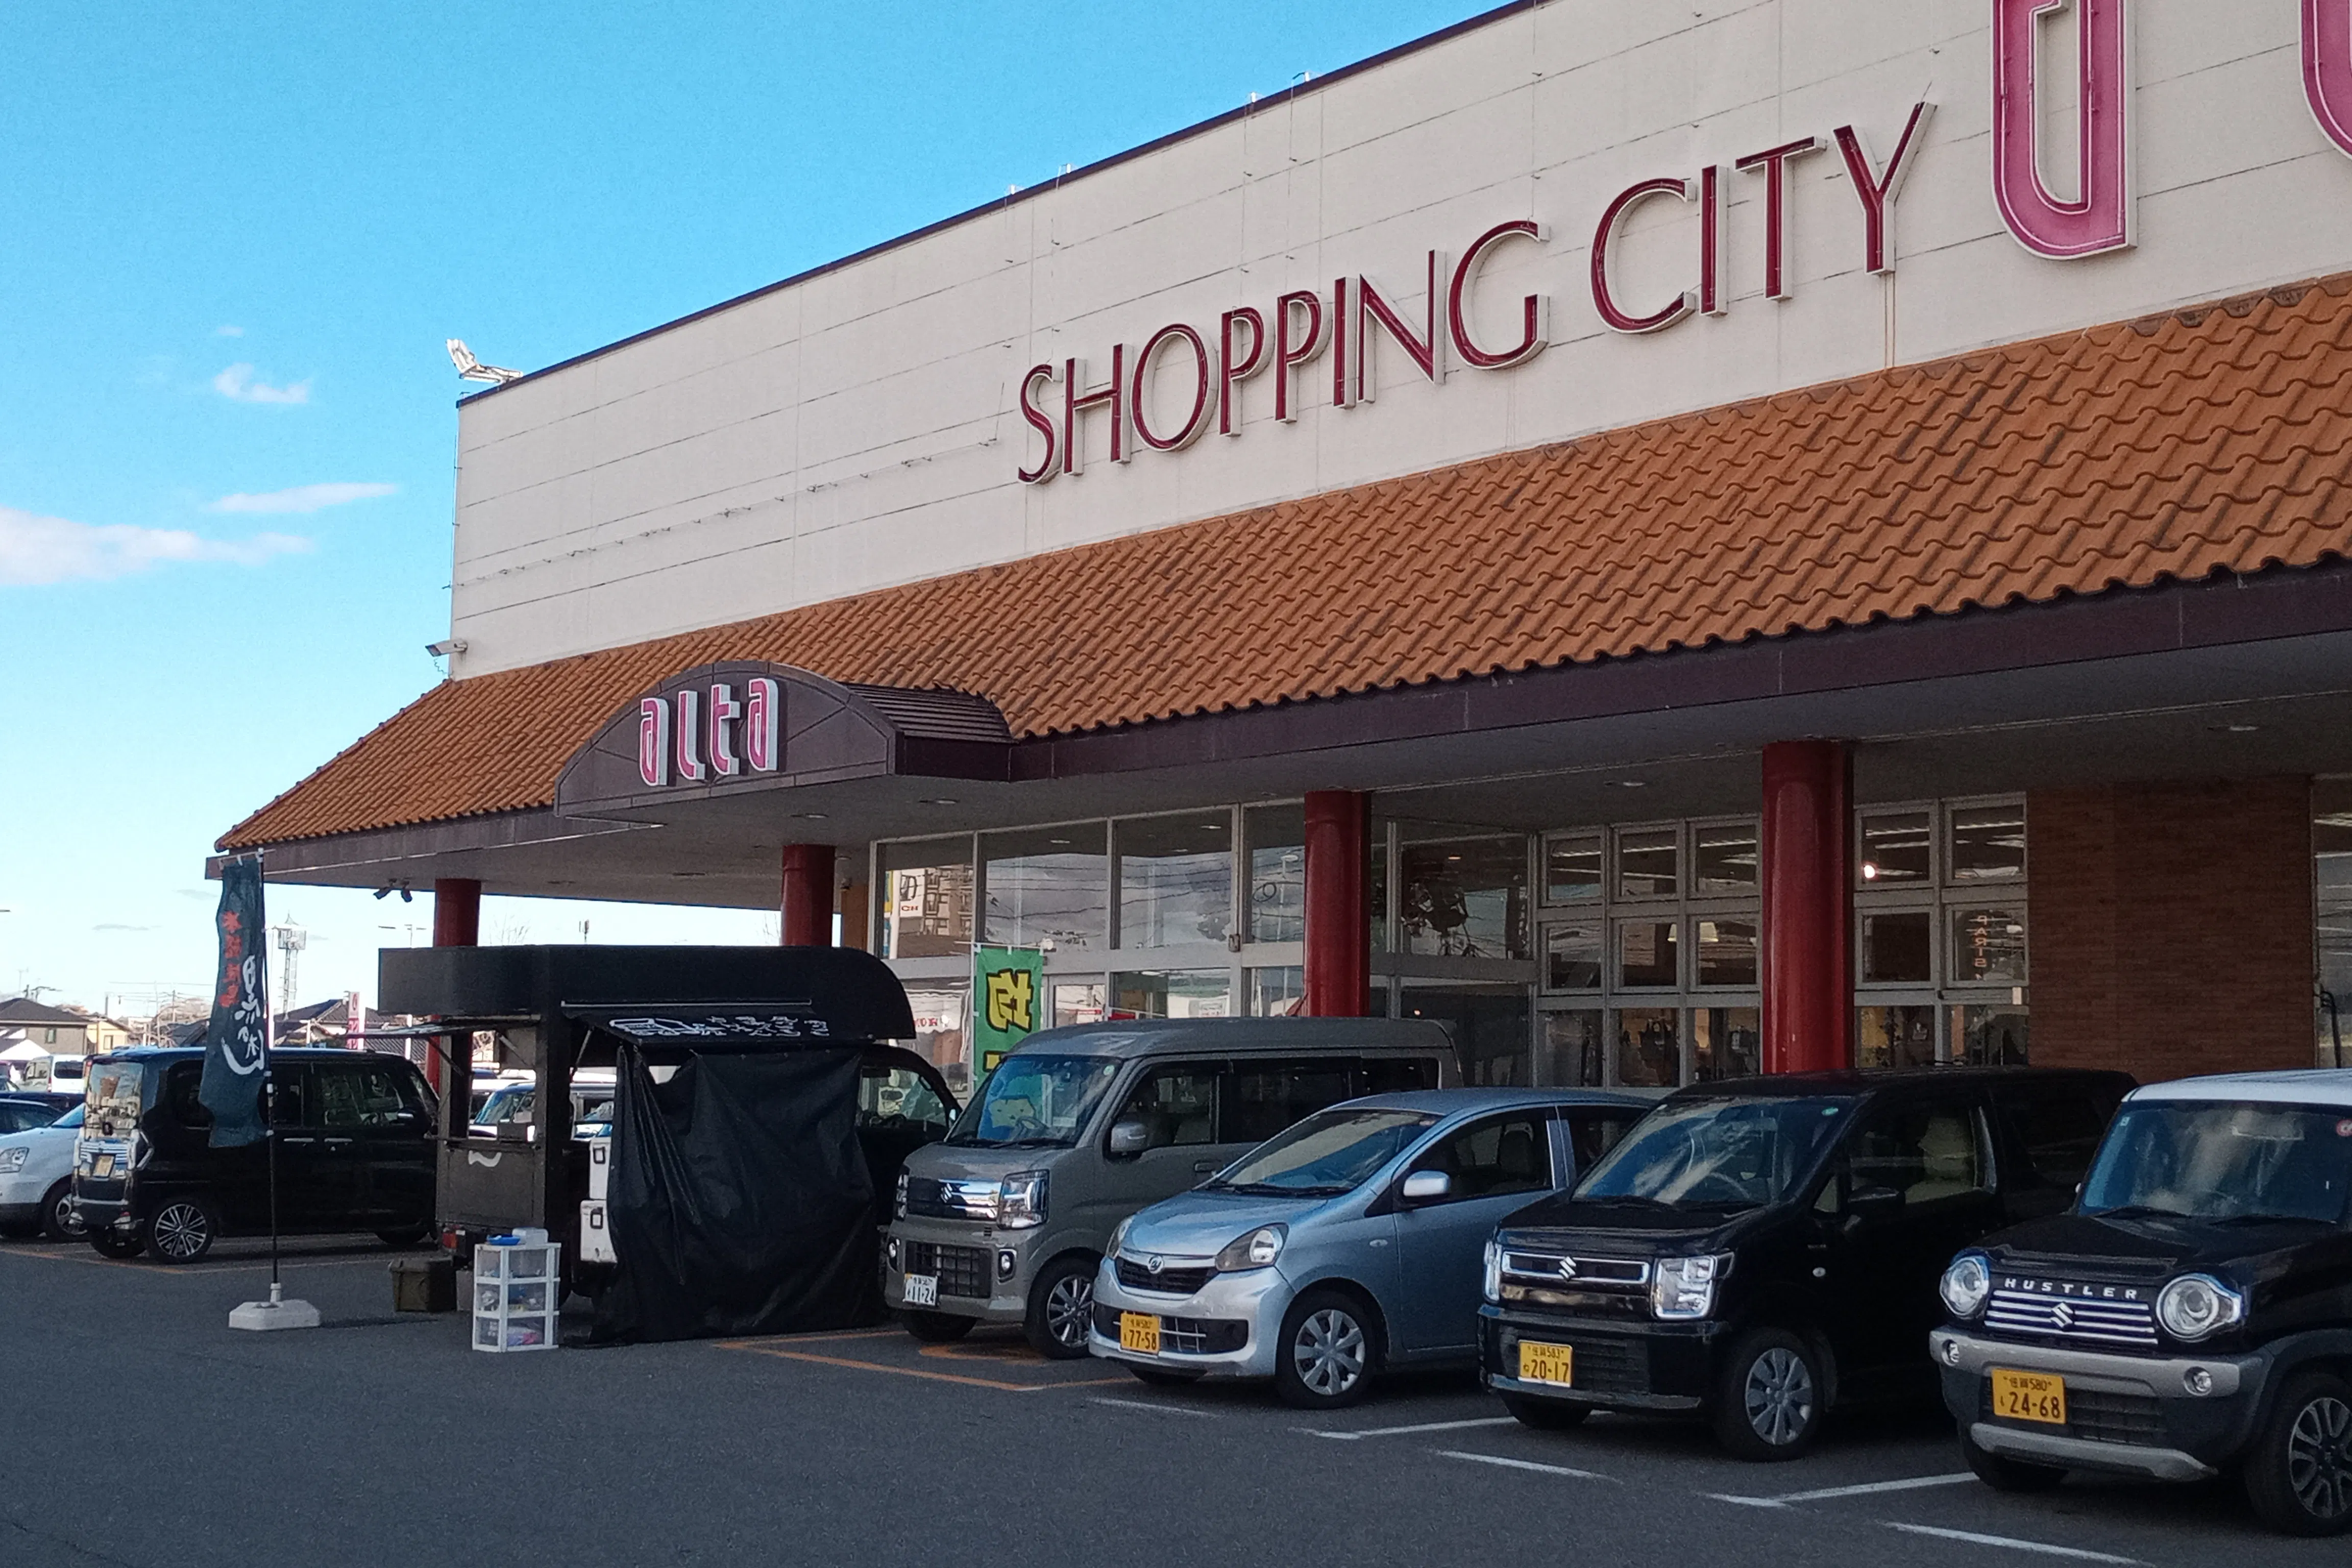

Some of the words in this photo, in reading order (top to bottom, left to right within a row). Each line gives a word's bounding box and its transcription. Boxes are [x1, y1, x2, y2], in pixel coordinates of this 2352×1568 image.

[1018, 219, 1550, 485] SHOPPING
[1589, 103, 1938, 335] CITY
[639, 677, 778, 786] alta
[2004, 1278, 2137, 1299] HUSTLER
[1129, 1329, 1157, 1350] 77-58
[1531, 1359, 1569, 1382] 20-17
[2009, 1391, 2061, 1419] 24-68
